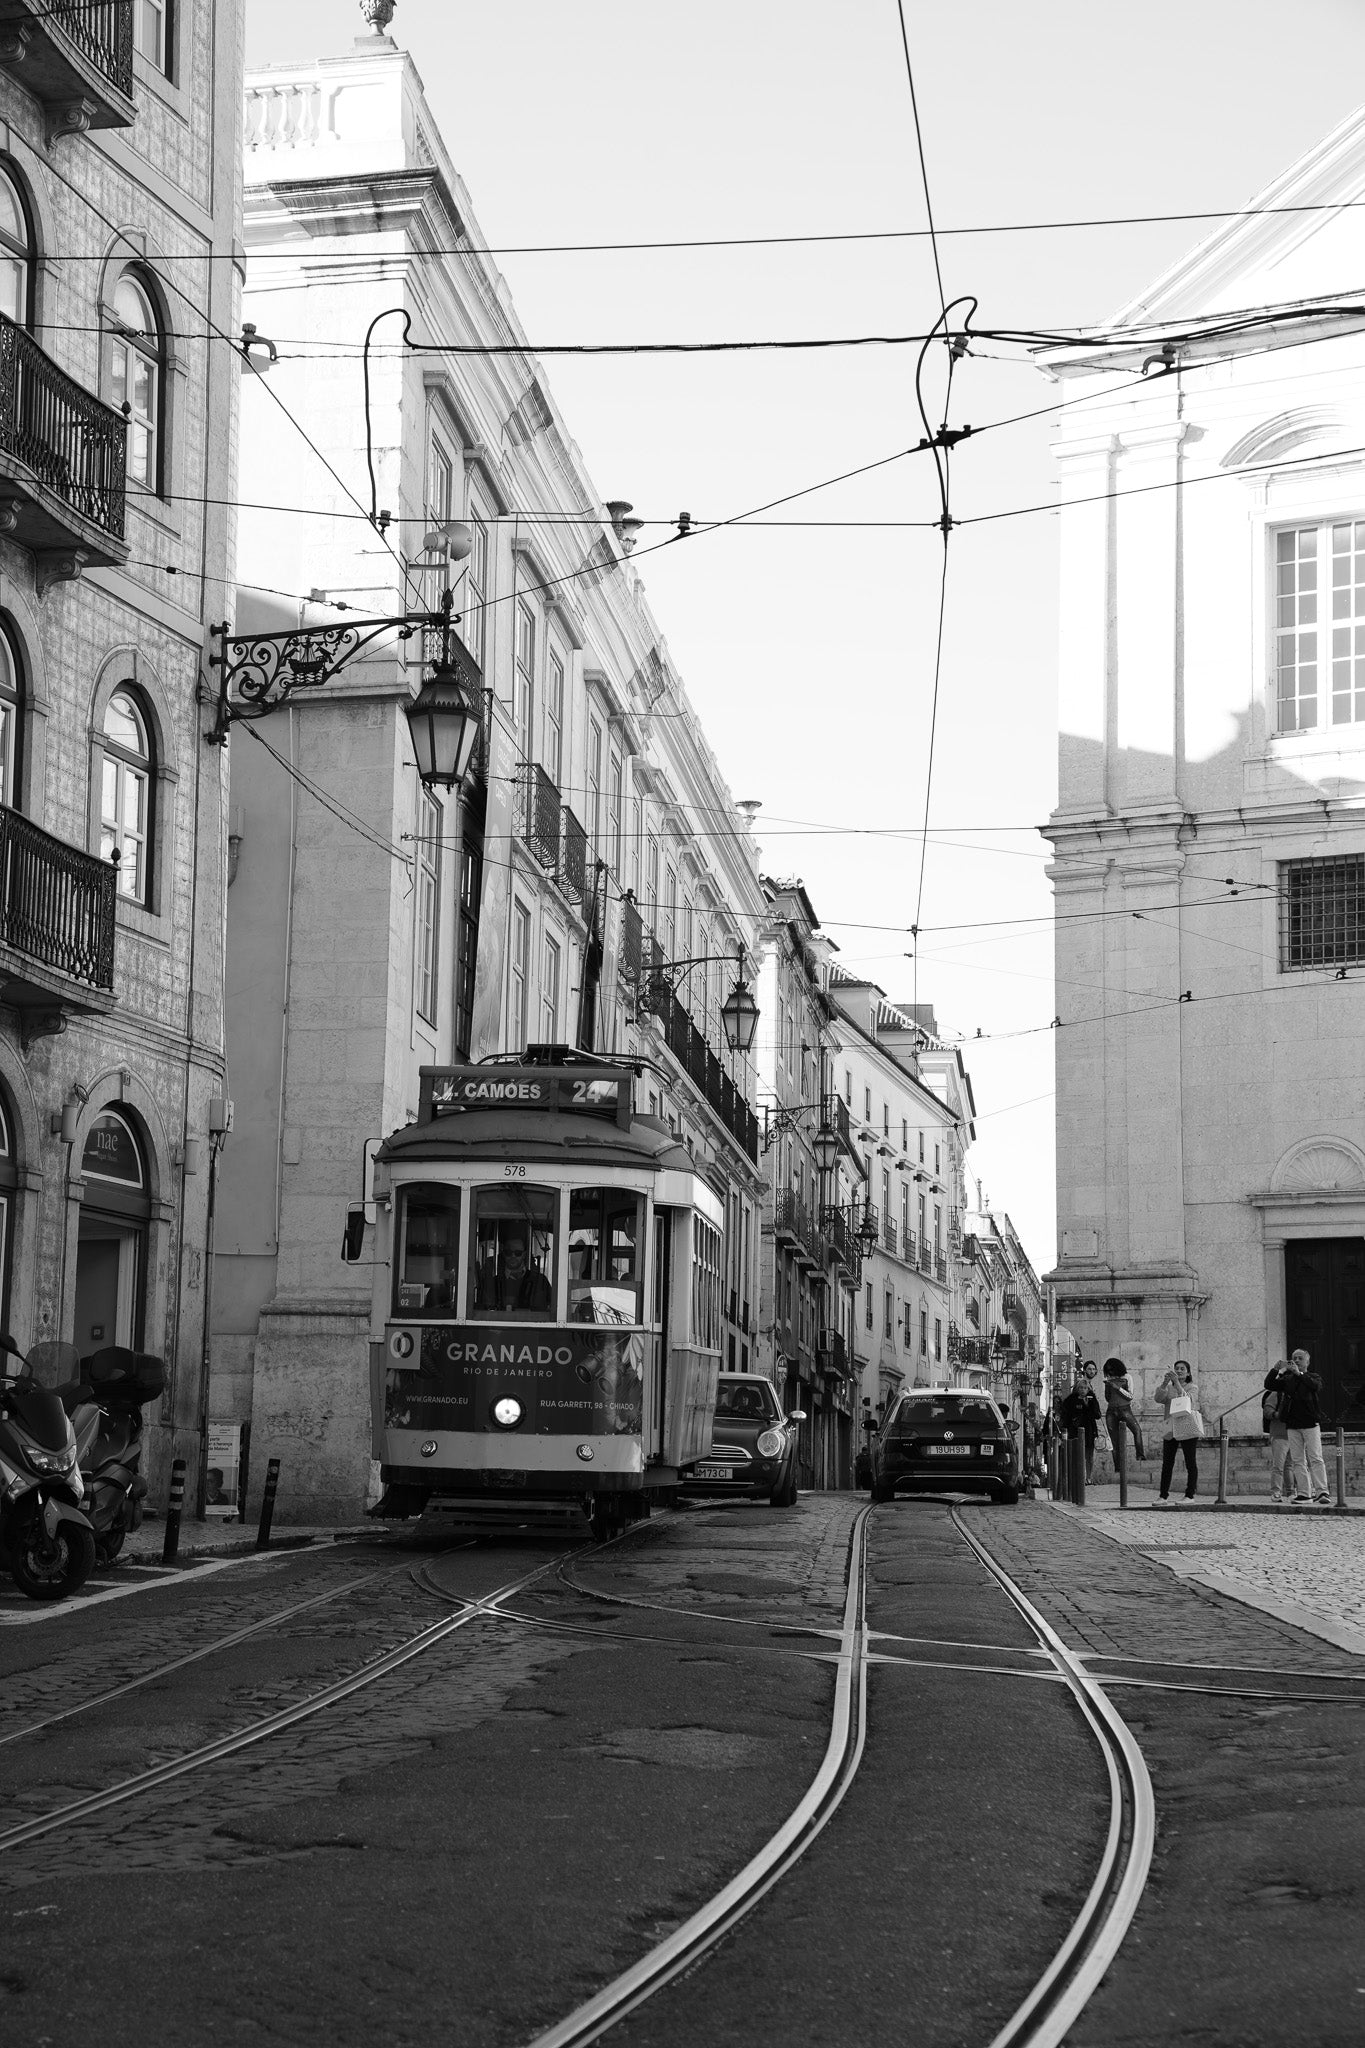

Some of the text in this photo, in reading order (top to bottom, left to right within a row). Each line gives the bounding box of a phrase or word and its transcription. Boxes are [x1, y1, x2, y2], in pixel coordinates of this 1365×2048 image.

[572, 1080, 601, 1103] 24
[97, 1131, 118, 1151] nae
[504, 1165, 526, 1177] 578
[400, 1298, 410, 1307] 02
[446, 1342, 573, 1365] GRANADO
[463, 1367, 481, 1375] RIO
[503, 1369, 553, 1378] JANEIRO
[540, 1399, 557, 1408] RUA
[557, 1400, 593, 1410] GARRETT,
[609, 1402, 634, 1411] CHIADO
